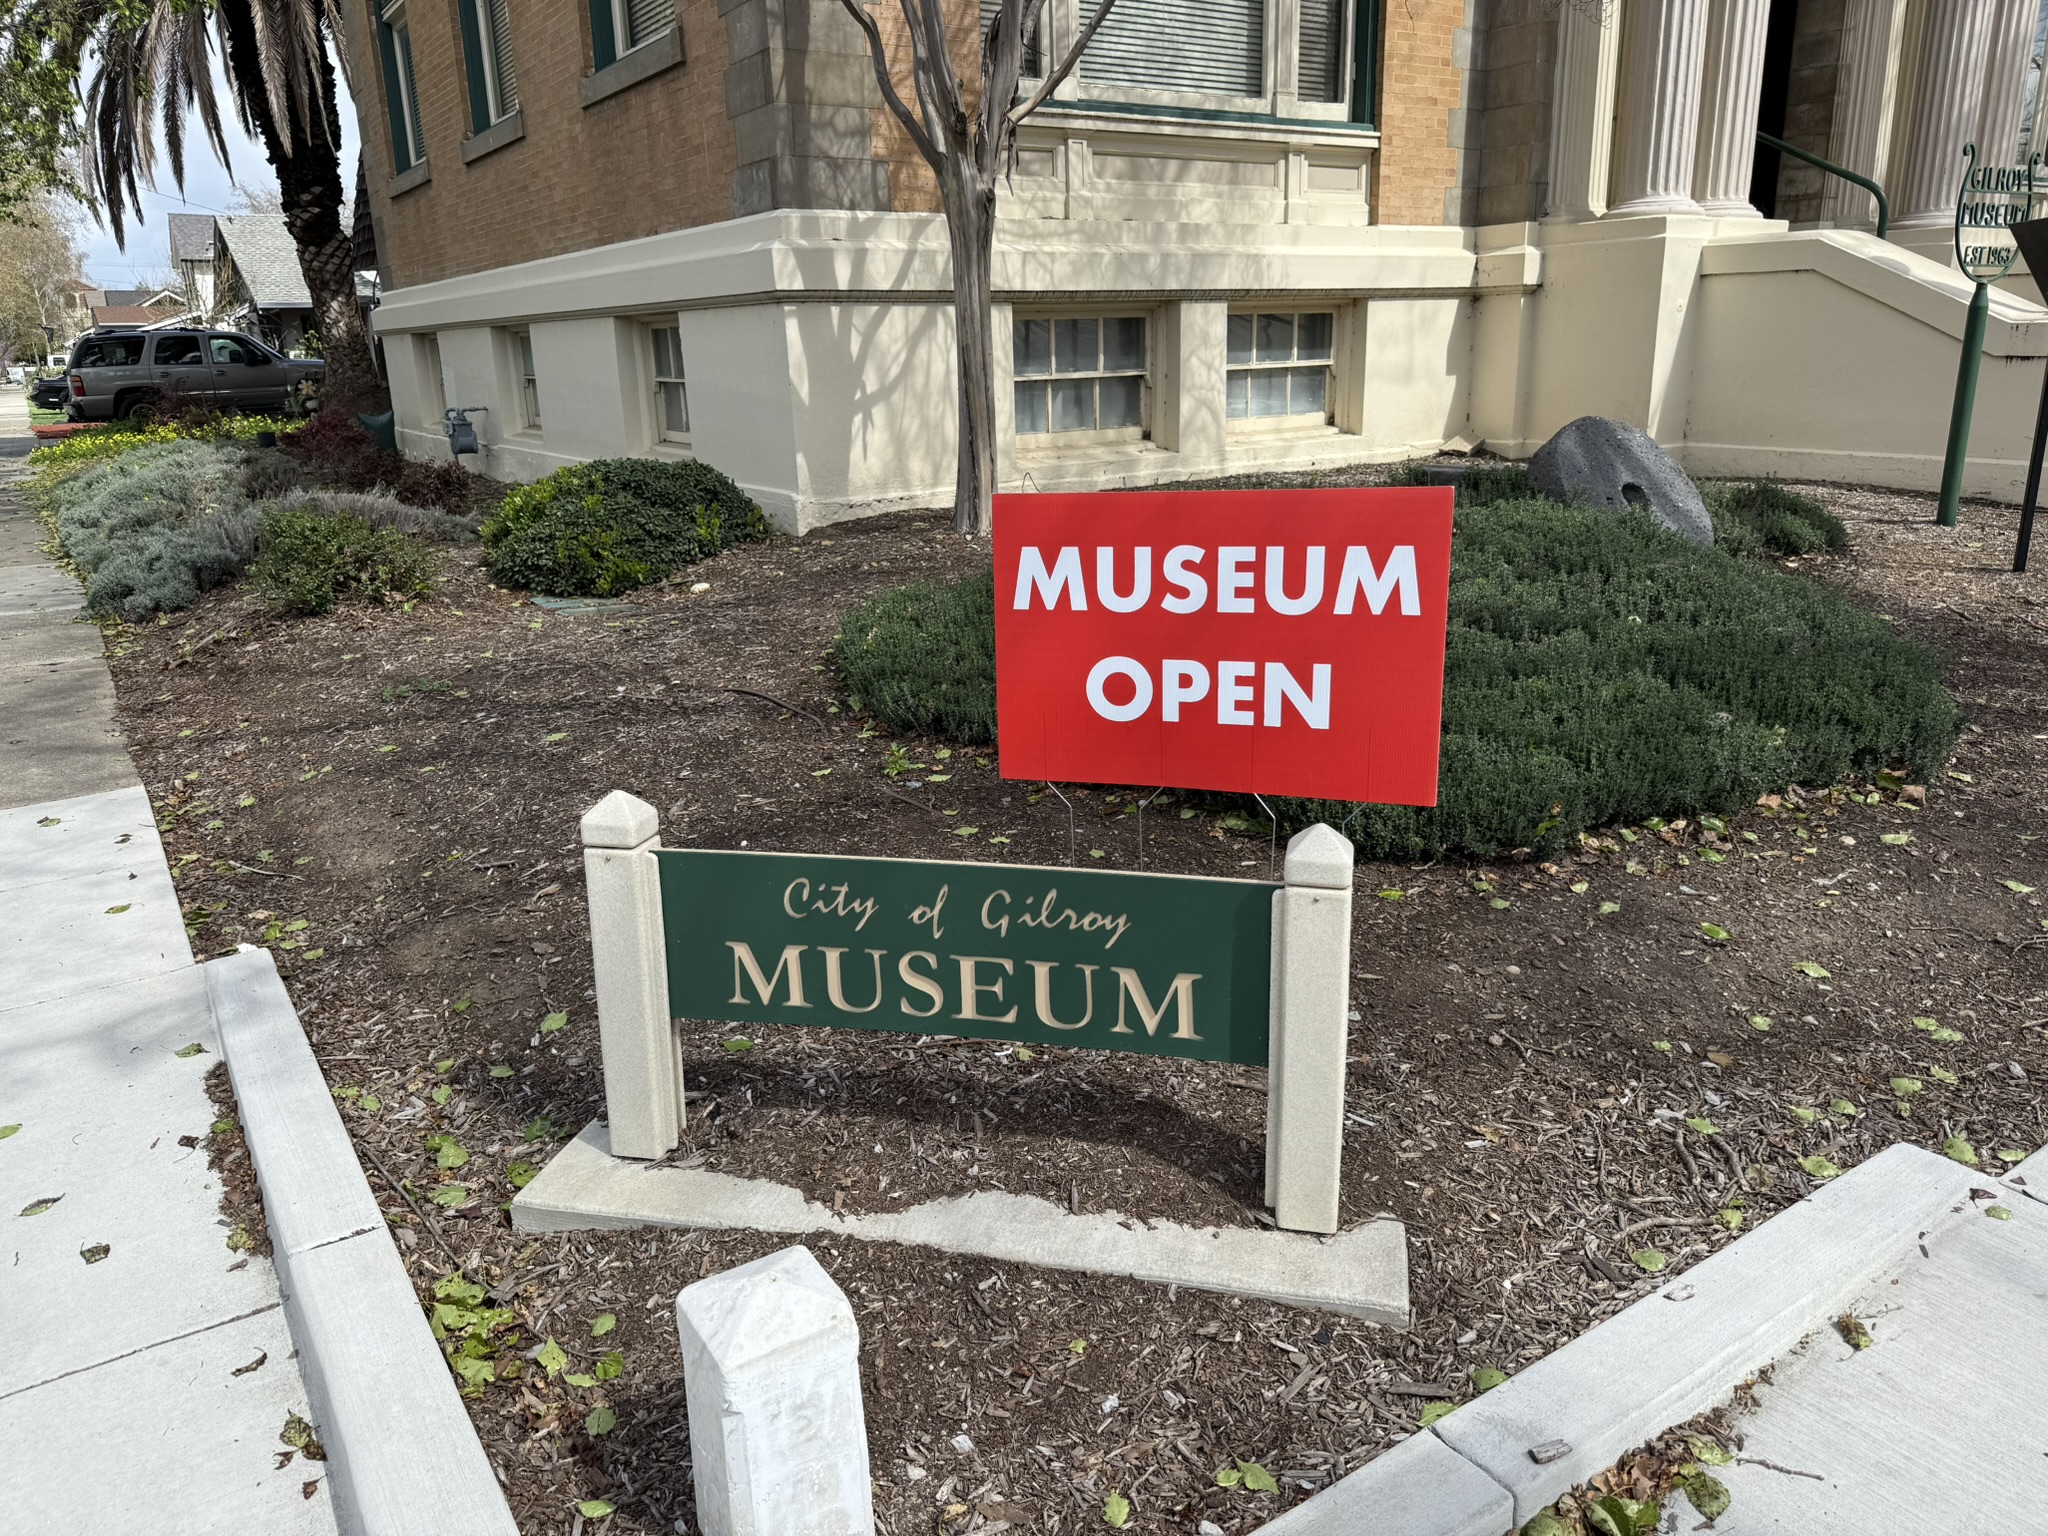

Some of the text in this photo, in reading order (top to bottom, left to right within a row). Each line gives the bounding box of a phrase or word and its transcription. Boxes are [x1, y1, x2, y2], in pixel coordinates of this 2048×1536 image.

[1961, 202, 2027, 226] MUSEUM
[1971, 167, 2026, 191] GILROY
[1964, 245, 2010, 265] EST 1963
[1013, 545, 1421, 615] MUSEUM
[1086, 656, 1331, 729] OPEN
[784, 878, 1130, 949] City of Gilroy
[726, 942, 1203, 1040] MUSEUM
